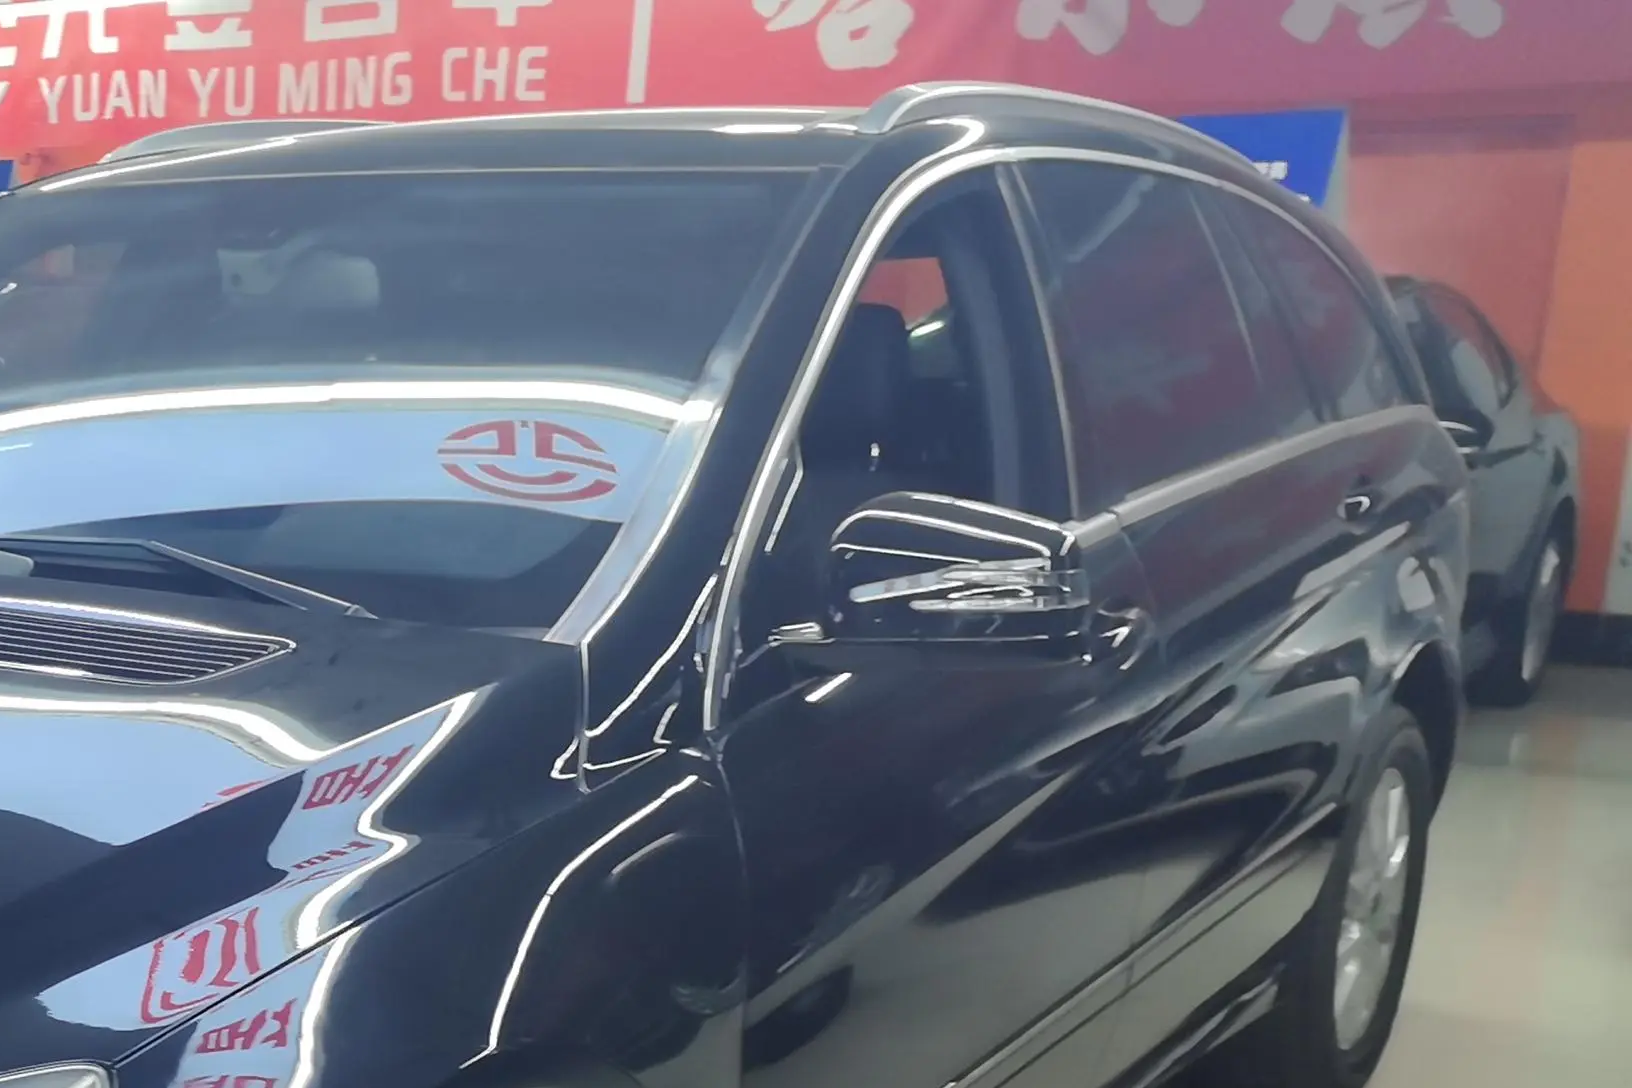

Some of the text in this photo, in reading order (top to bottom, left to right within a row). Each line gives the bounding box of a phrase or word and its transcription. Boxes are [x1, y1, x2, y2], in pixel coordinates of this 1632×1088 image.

[38, 46, 549, 124] YUAN YU MING CHE
